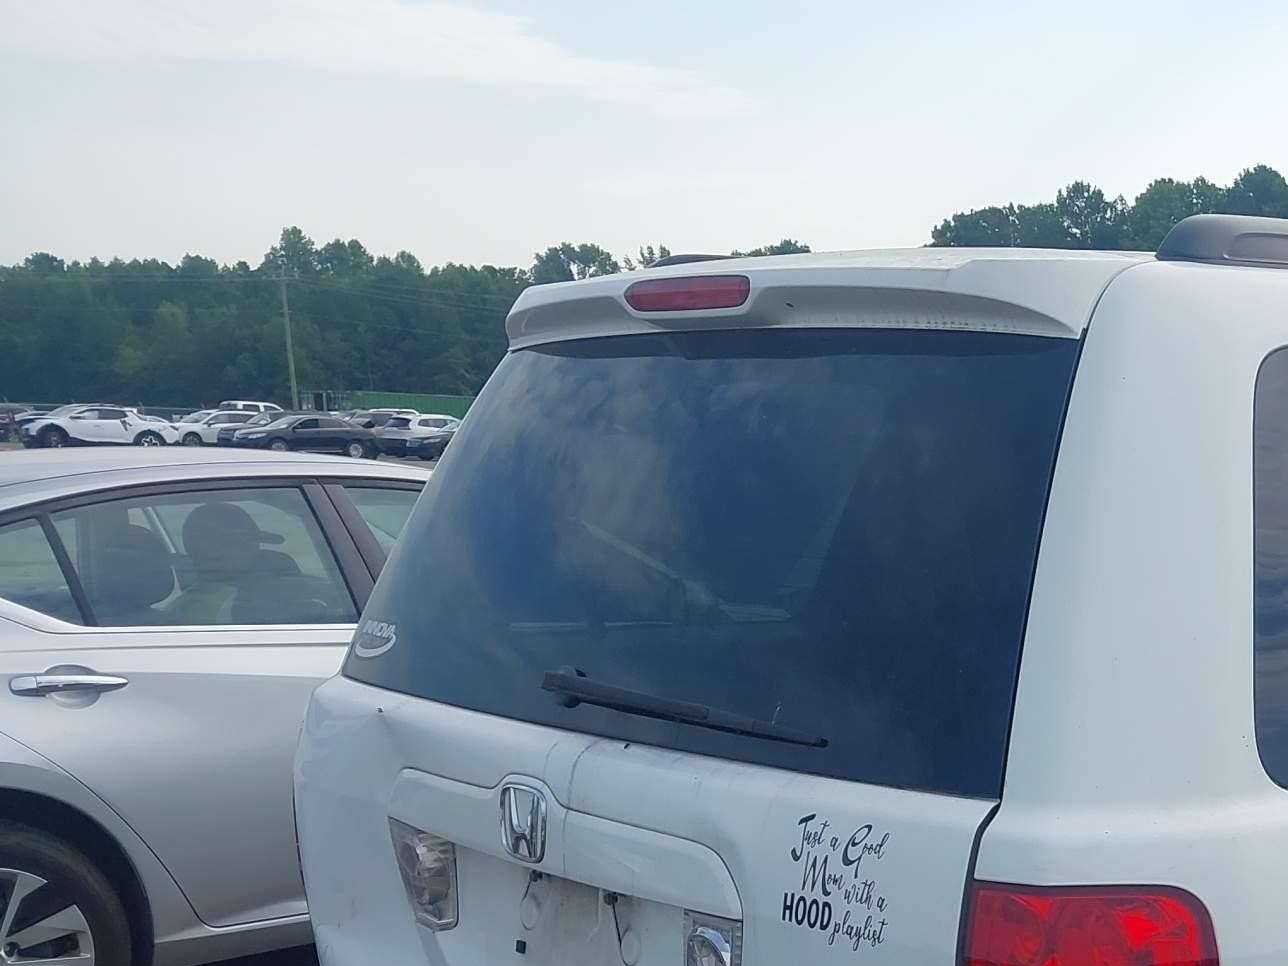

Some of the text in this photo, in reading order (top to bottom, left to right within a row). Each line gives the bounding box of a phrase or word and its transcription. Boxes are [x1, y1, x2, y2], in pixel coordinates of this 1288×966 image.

[791, 813, 890, 879] Just a Good
[801, 851, 888, 912] Mom with a
[782, 892, 888, 951] HOOD playlist
